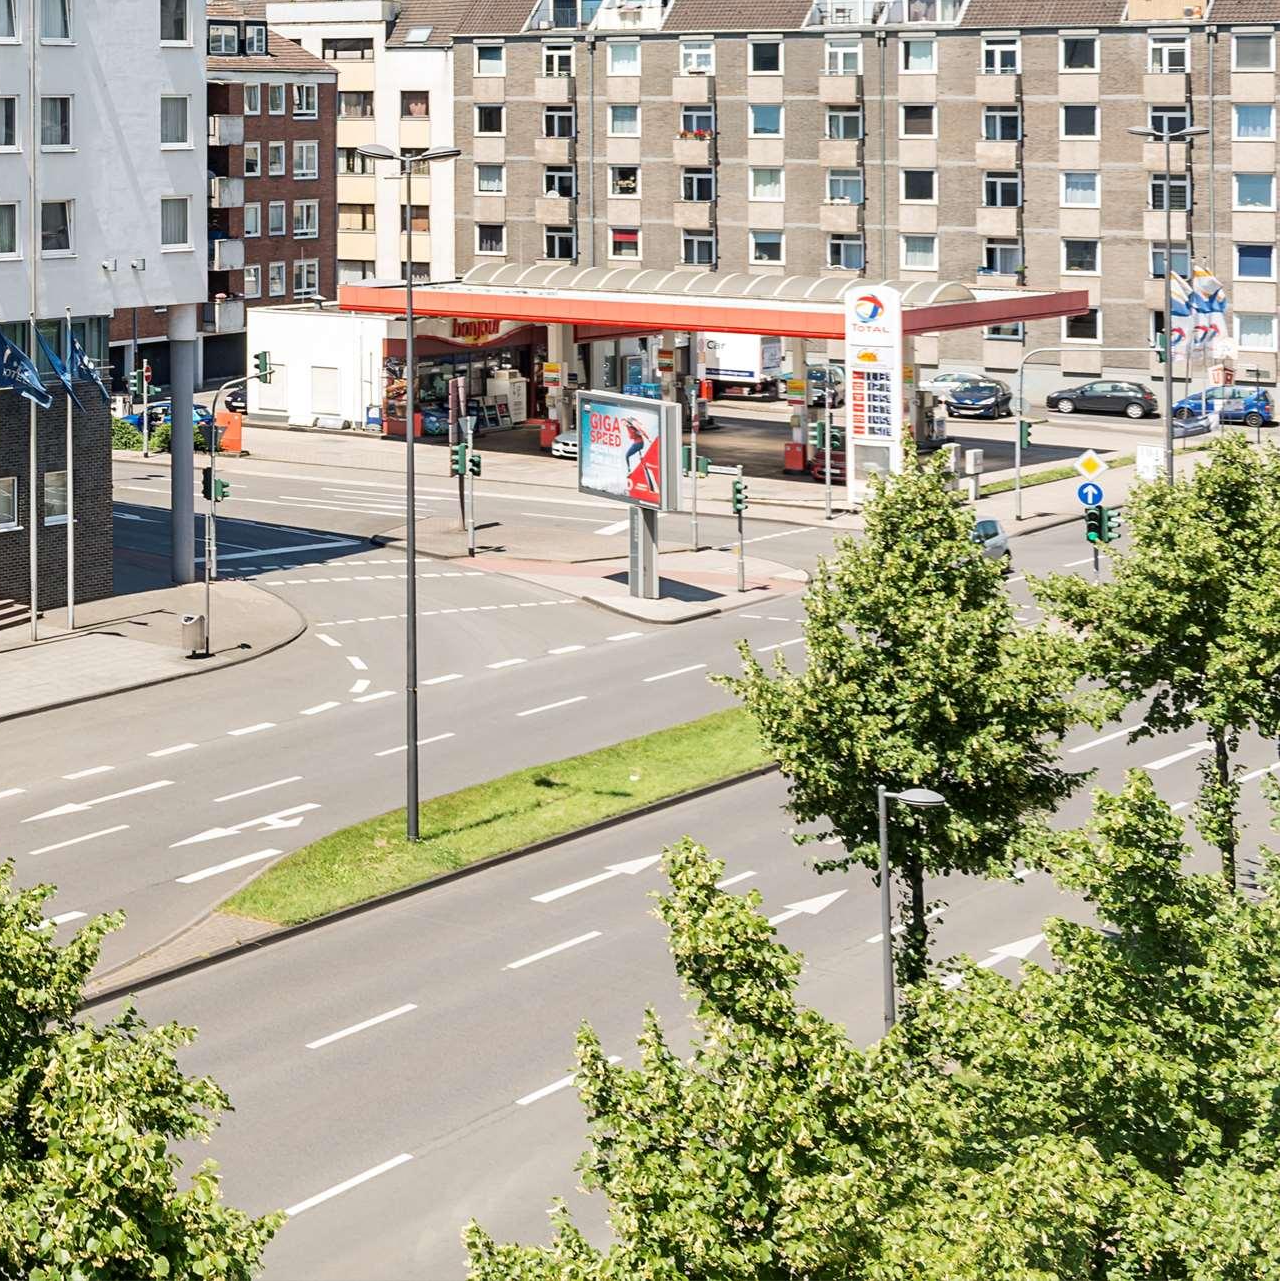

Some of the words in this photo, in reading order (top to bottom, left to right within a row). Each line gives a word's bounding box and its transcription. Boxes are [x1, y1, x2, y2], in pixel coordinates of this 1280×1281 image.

[453, 318, 501, 340] bonjour
[590, 411, 621, 433] GIGA
[590, 429, 622, 448] SPEED
